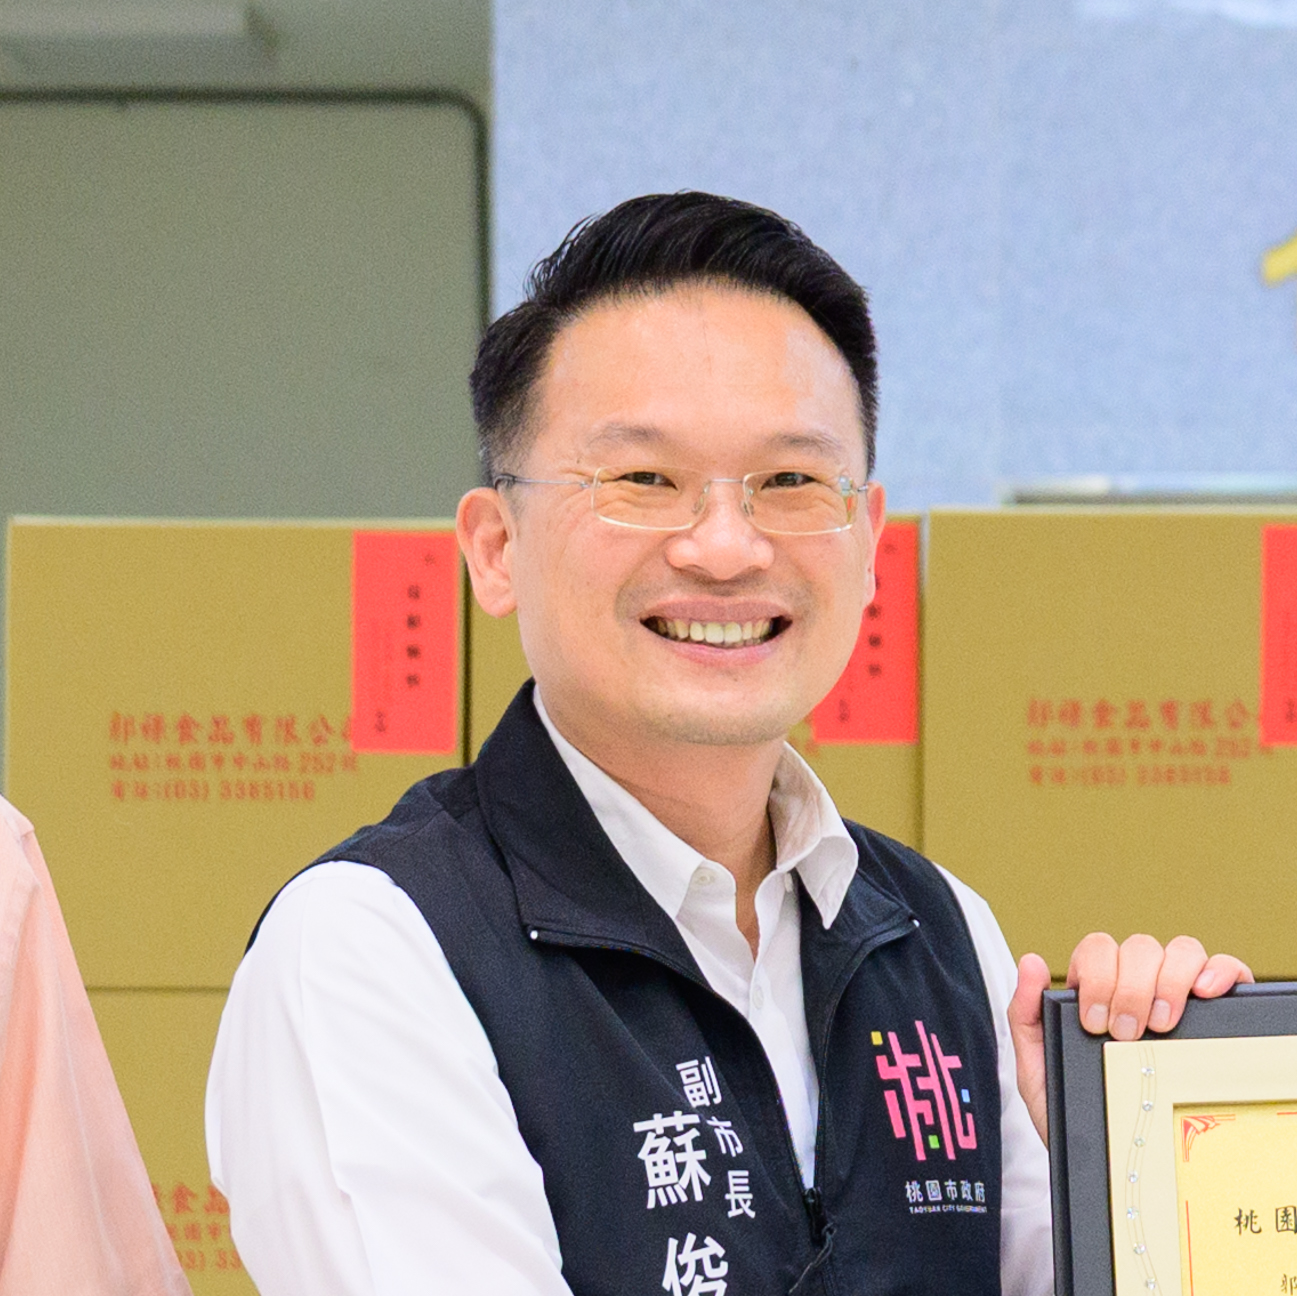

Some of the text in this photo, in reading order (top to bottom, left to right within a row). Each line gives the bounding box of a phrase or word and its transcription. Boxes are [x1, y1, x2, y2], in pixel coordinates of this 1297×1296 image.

[676, 1056, 756, 1219] 副市長
[905, 1179, 986, 1203] 桃園市政府
